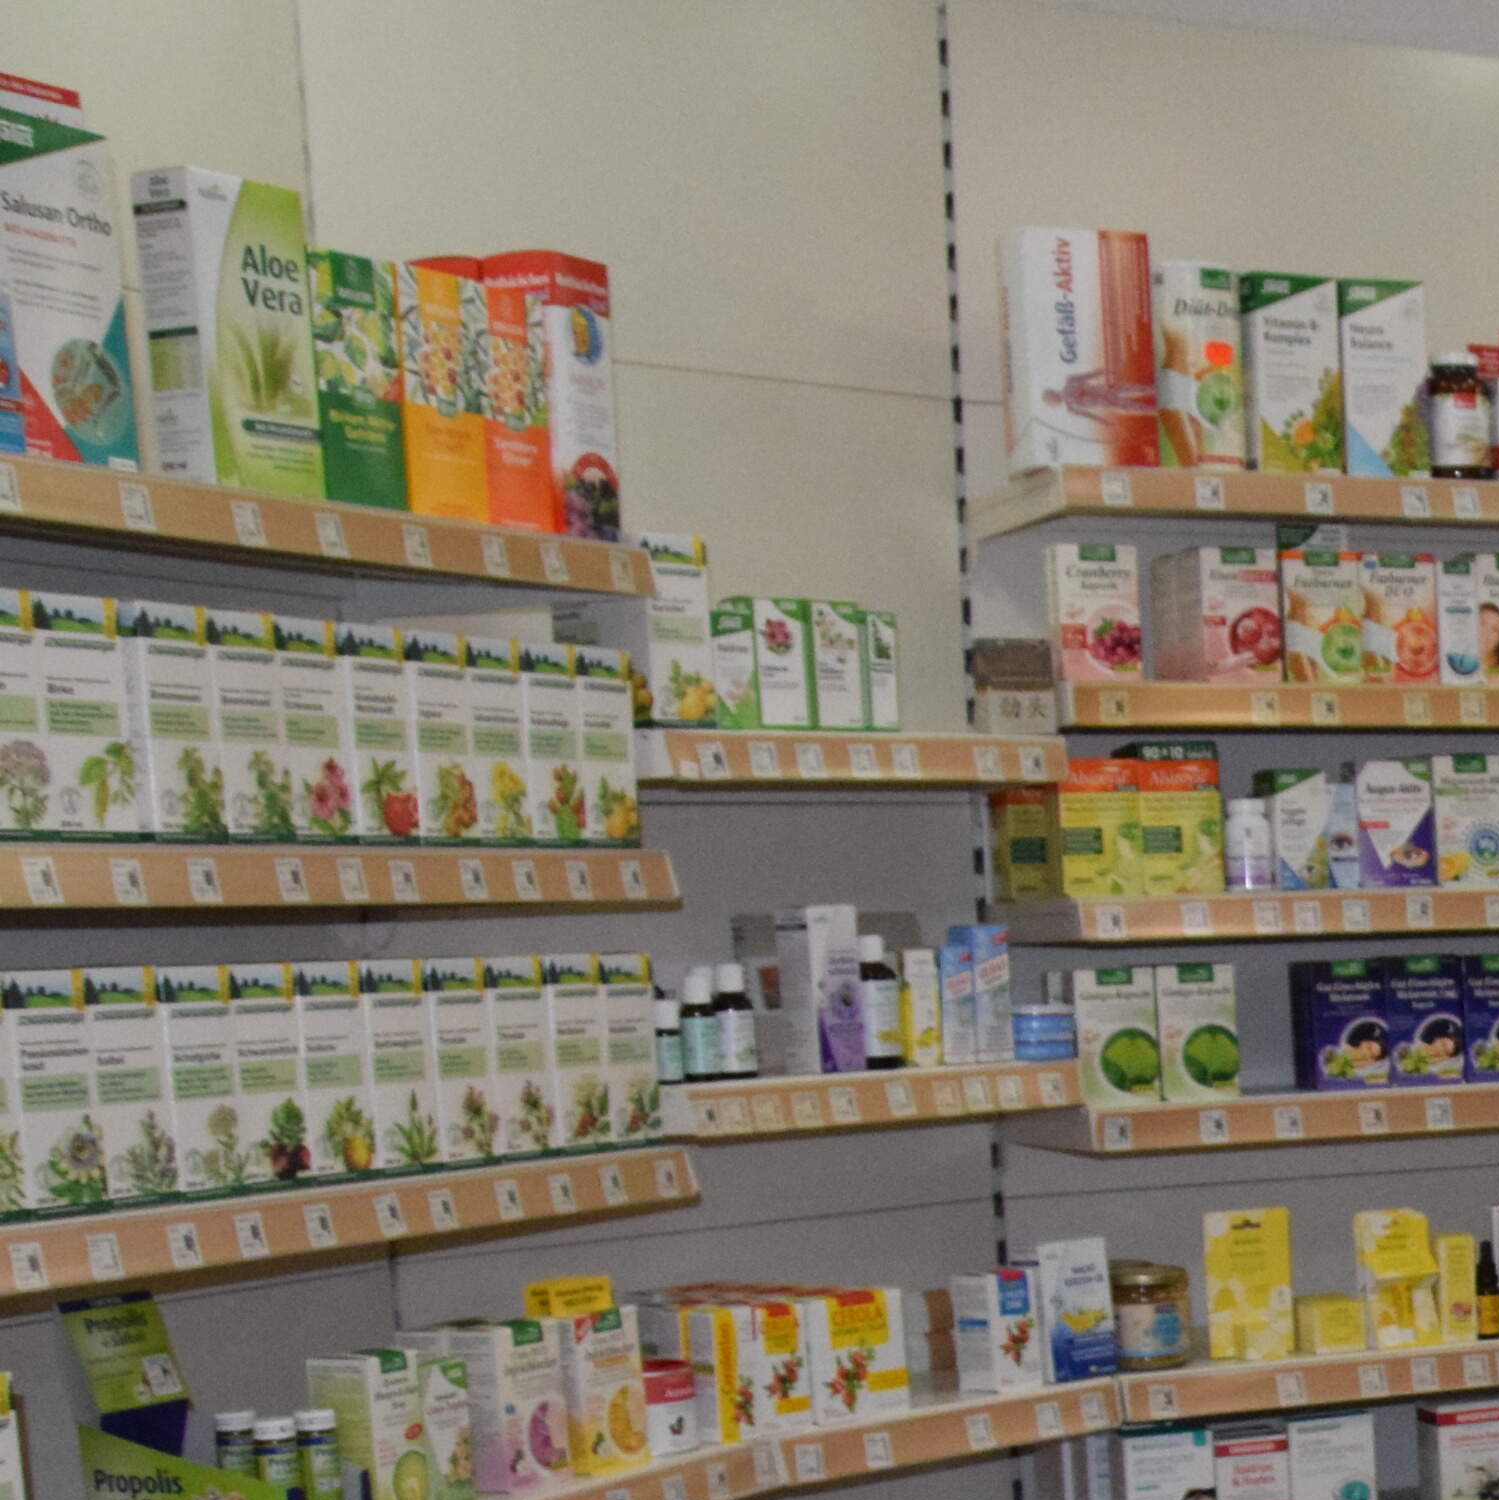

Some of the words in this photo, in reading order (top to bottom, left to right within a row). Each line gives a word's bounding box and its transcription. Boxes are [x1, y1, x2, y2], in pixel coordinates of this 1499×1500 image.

[68, 207, 112, 236] Ortho
[241, 244, 299, 282] Aloe
[241, 277, 303, 316] Vera
[93, 1469, 183, 1498] Propolis
